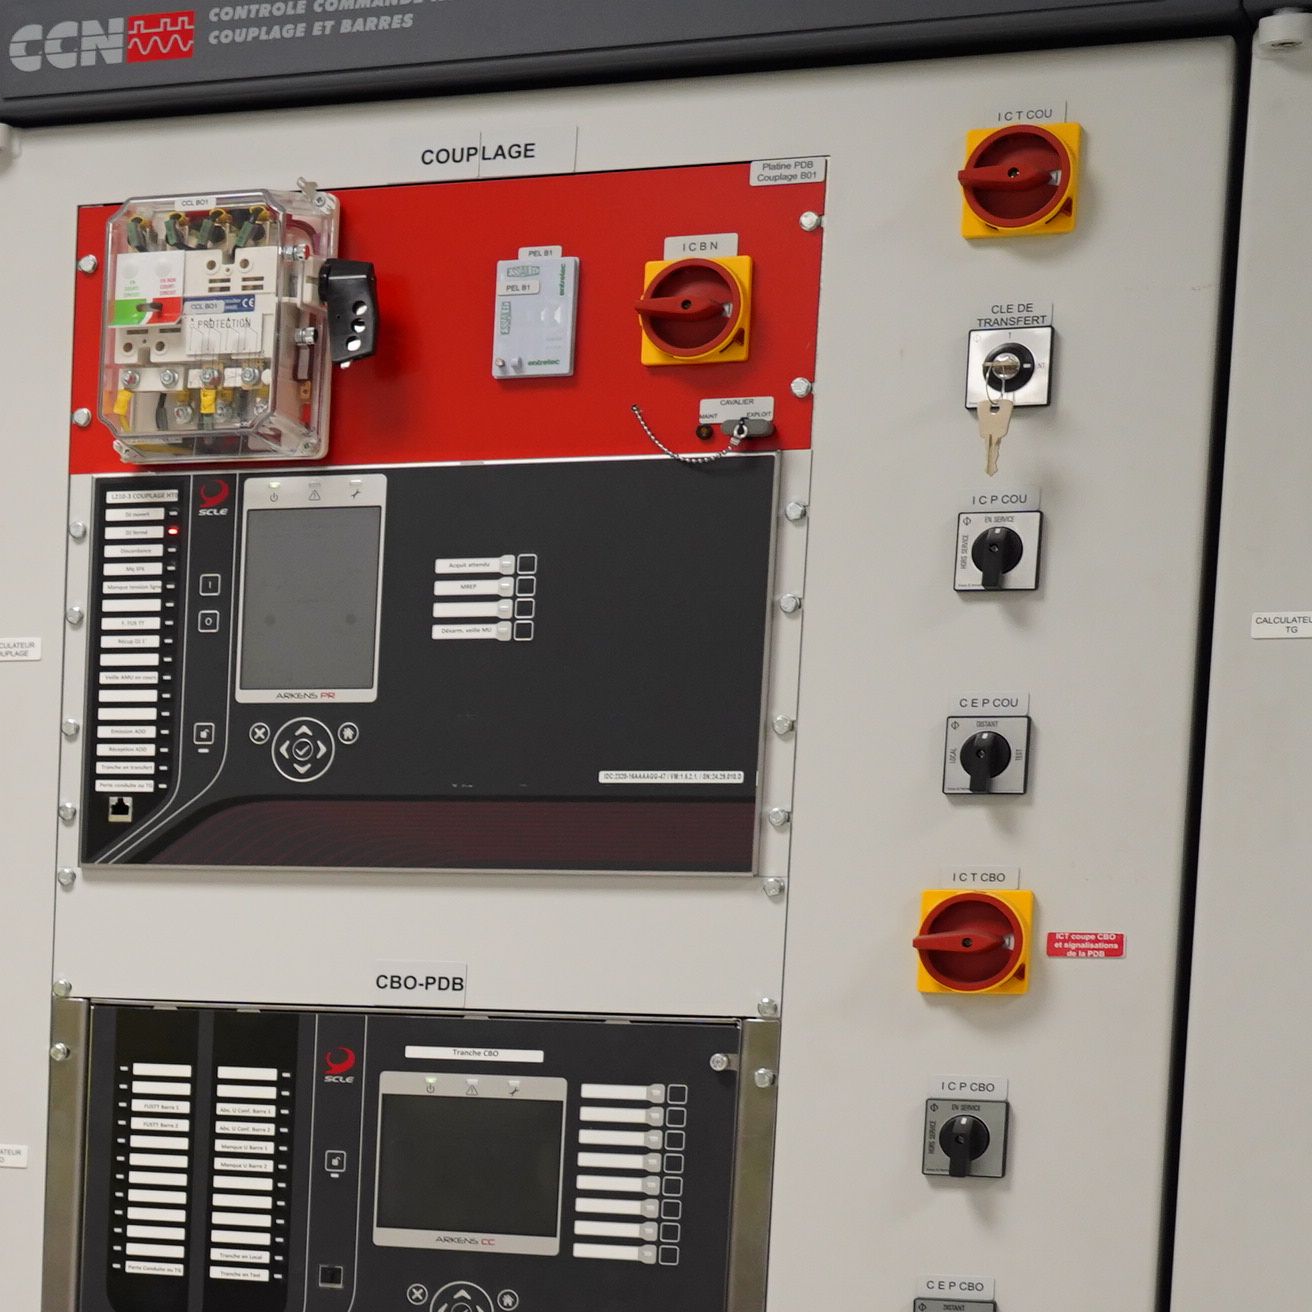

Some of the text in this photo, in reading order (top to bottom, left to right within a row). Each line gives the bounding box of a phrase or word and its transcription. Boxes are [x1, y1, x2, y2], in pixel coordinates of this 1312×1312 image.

[208, 1, 307, 22] CONTROLE
[208, 13, 414, 45] COUPLAGE ET BARRES
[9, 17, 125, 72] CCN
[421, 143, 535, 165] COUPLAGE
[762, 160, 814, 171] Platine PDB
[757, 173, 798, 184] Couplage
[991, 303, 1034, 315] CLE DE
[977, 315, 1047, 327] TRANSFERT
[719, 398, 755, 406] CAVALIER
[198, 508, 229, 516] SCLE
[1286, 626, 1298, 634] TG
[1071, 934, 1095, 942] coupe
[1064, 942, 1119, 951] signalisations
[375, 974, 465, 991] CBO-PDB
[453, 1049, 499, 1057] Tranche CBO
[324, 1075, 355, 1084] SCLE
[435, 1236, 479, 1245] ARKENS
